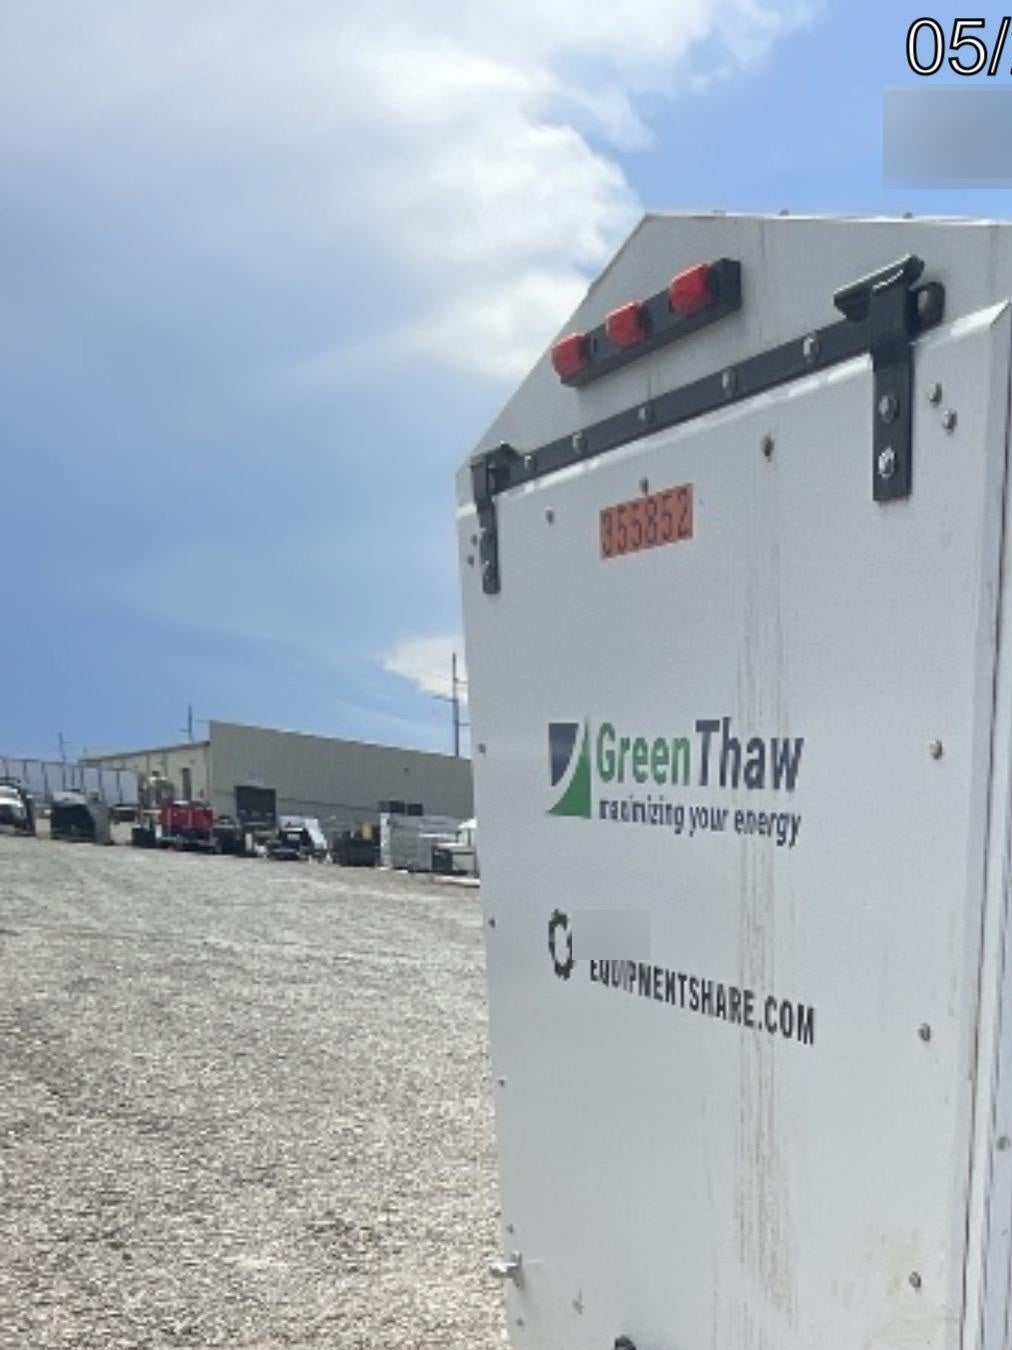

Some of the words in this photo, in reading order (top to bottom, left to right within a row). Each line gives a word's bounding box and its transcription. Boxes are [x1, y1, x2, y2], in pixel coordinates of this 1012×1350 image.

[603, 488, 688, 556] 355852
[597, 717, 804, 791] GreenThaw
[689, 804, 729, 837] your
[734, 809, 801, 848] energy
